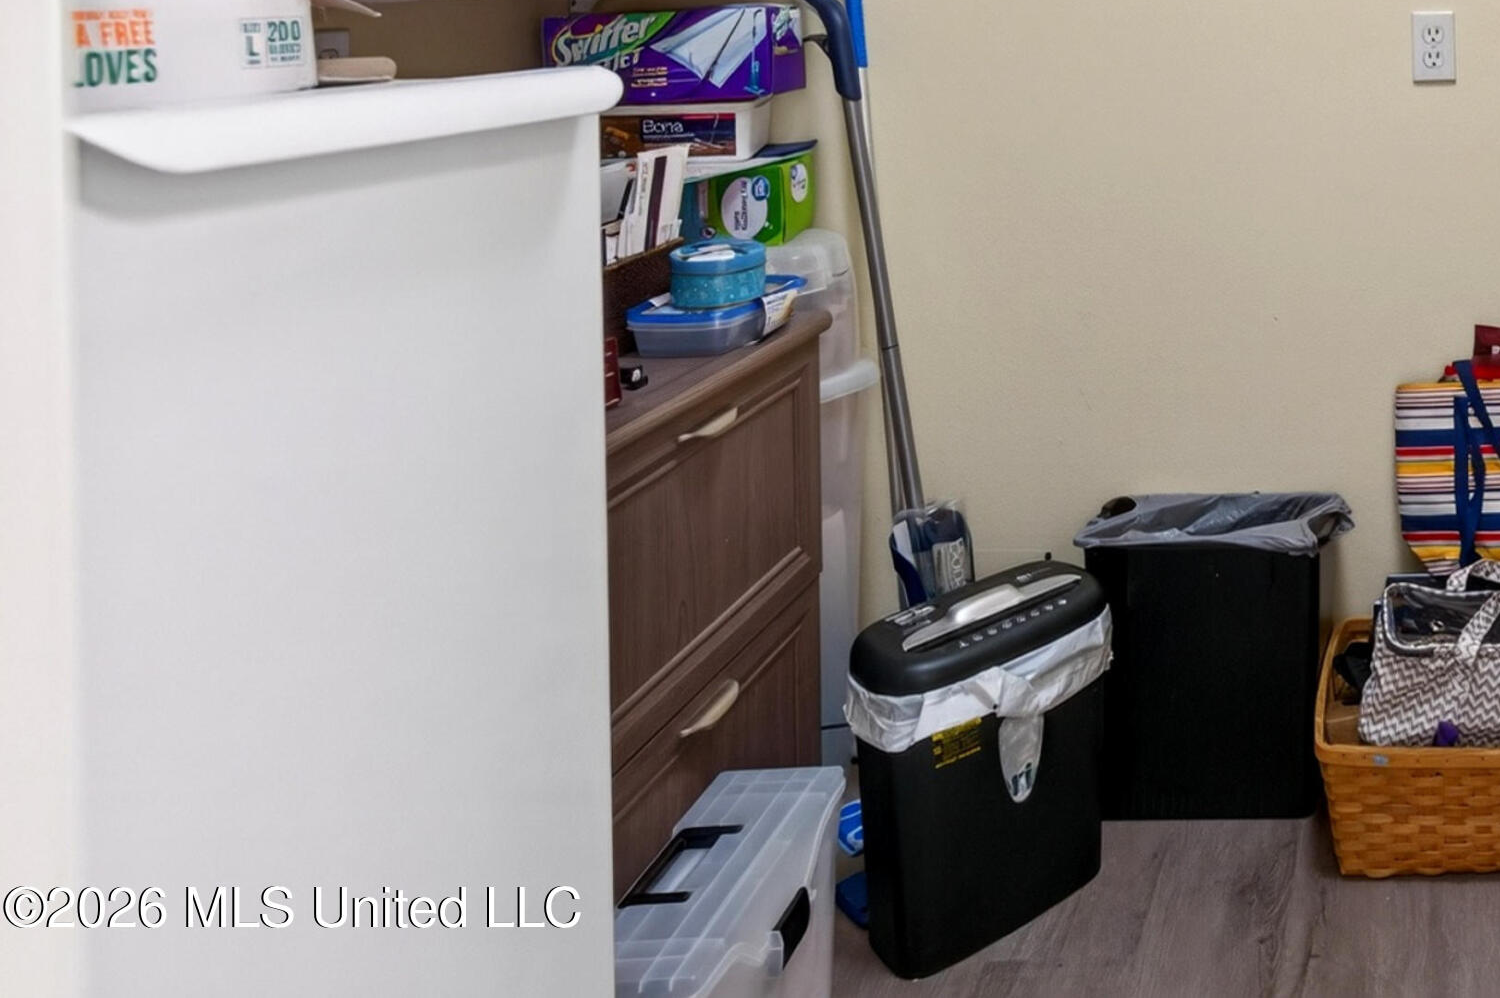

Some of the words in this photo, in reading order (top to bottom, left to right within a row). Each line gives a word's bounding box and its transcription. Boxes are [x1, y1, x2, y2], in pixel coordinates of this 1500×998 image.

[99, 19, 156, 48] FREE
[266, 19, 302, 42] 200
[554, 13, 656, 66] Swiffer
[244, 34, 260, 57] L
[642, 118, 685, 134] Bona
